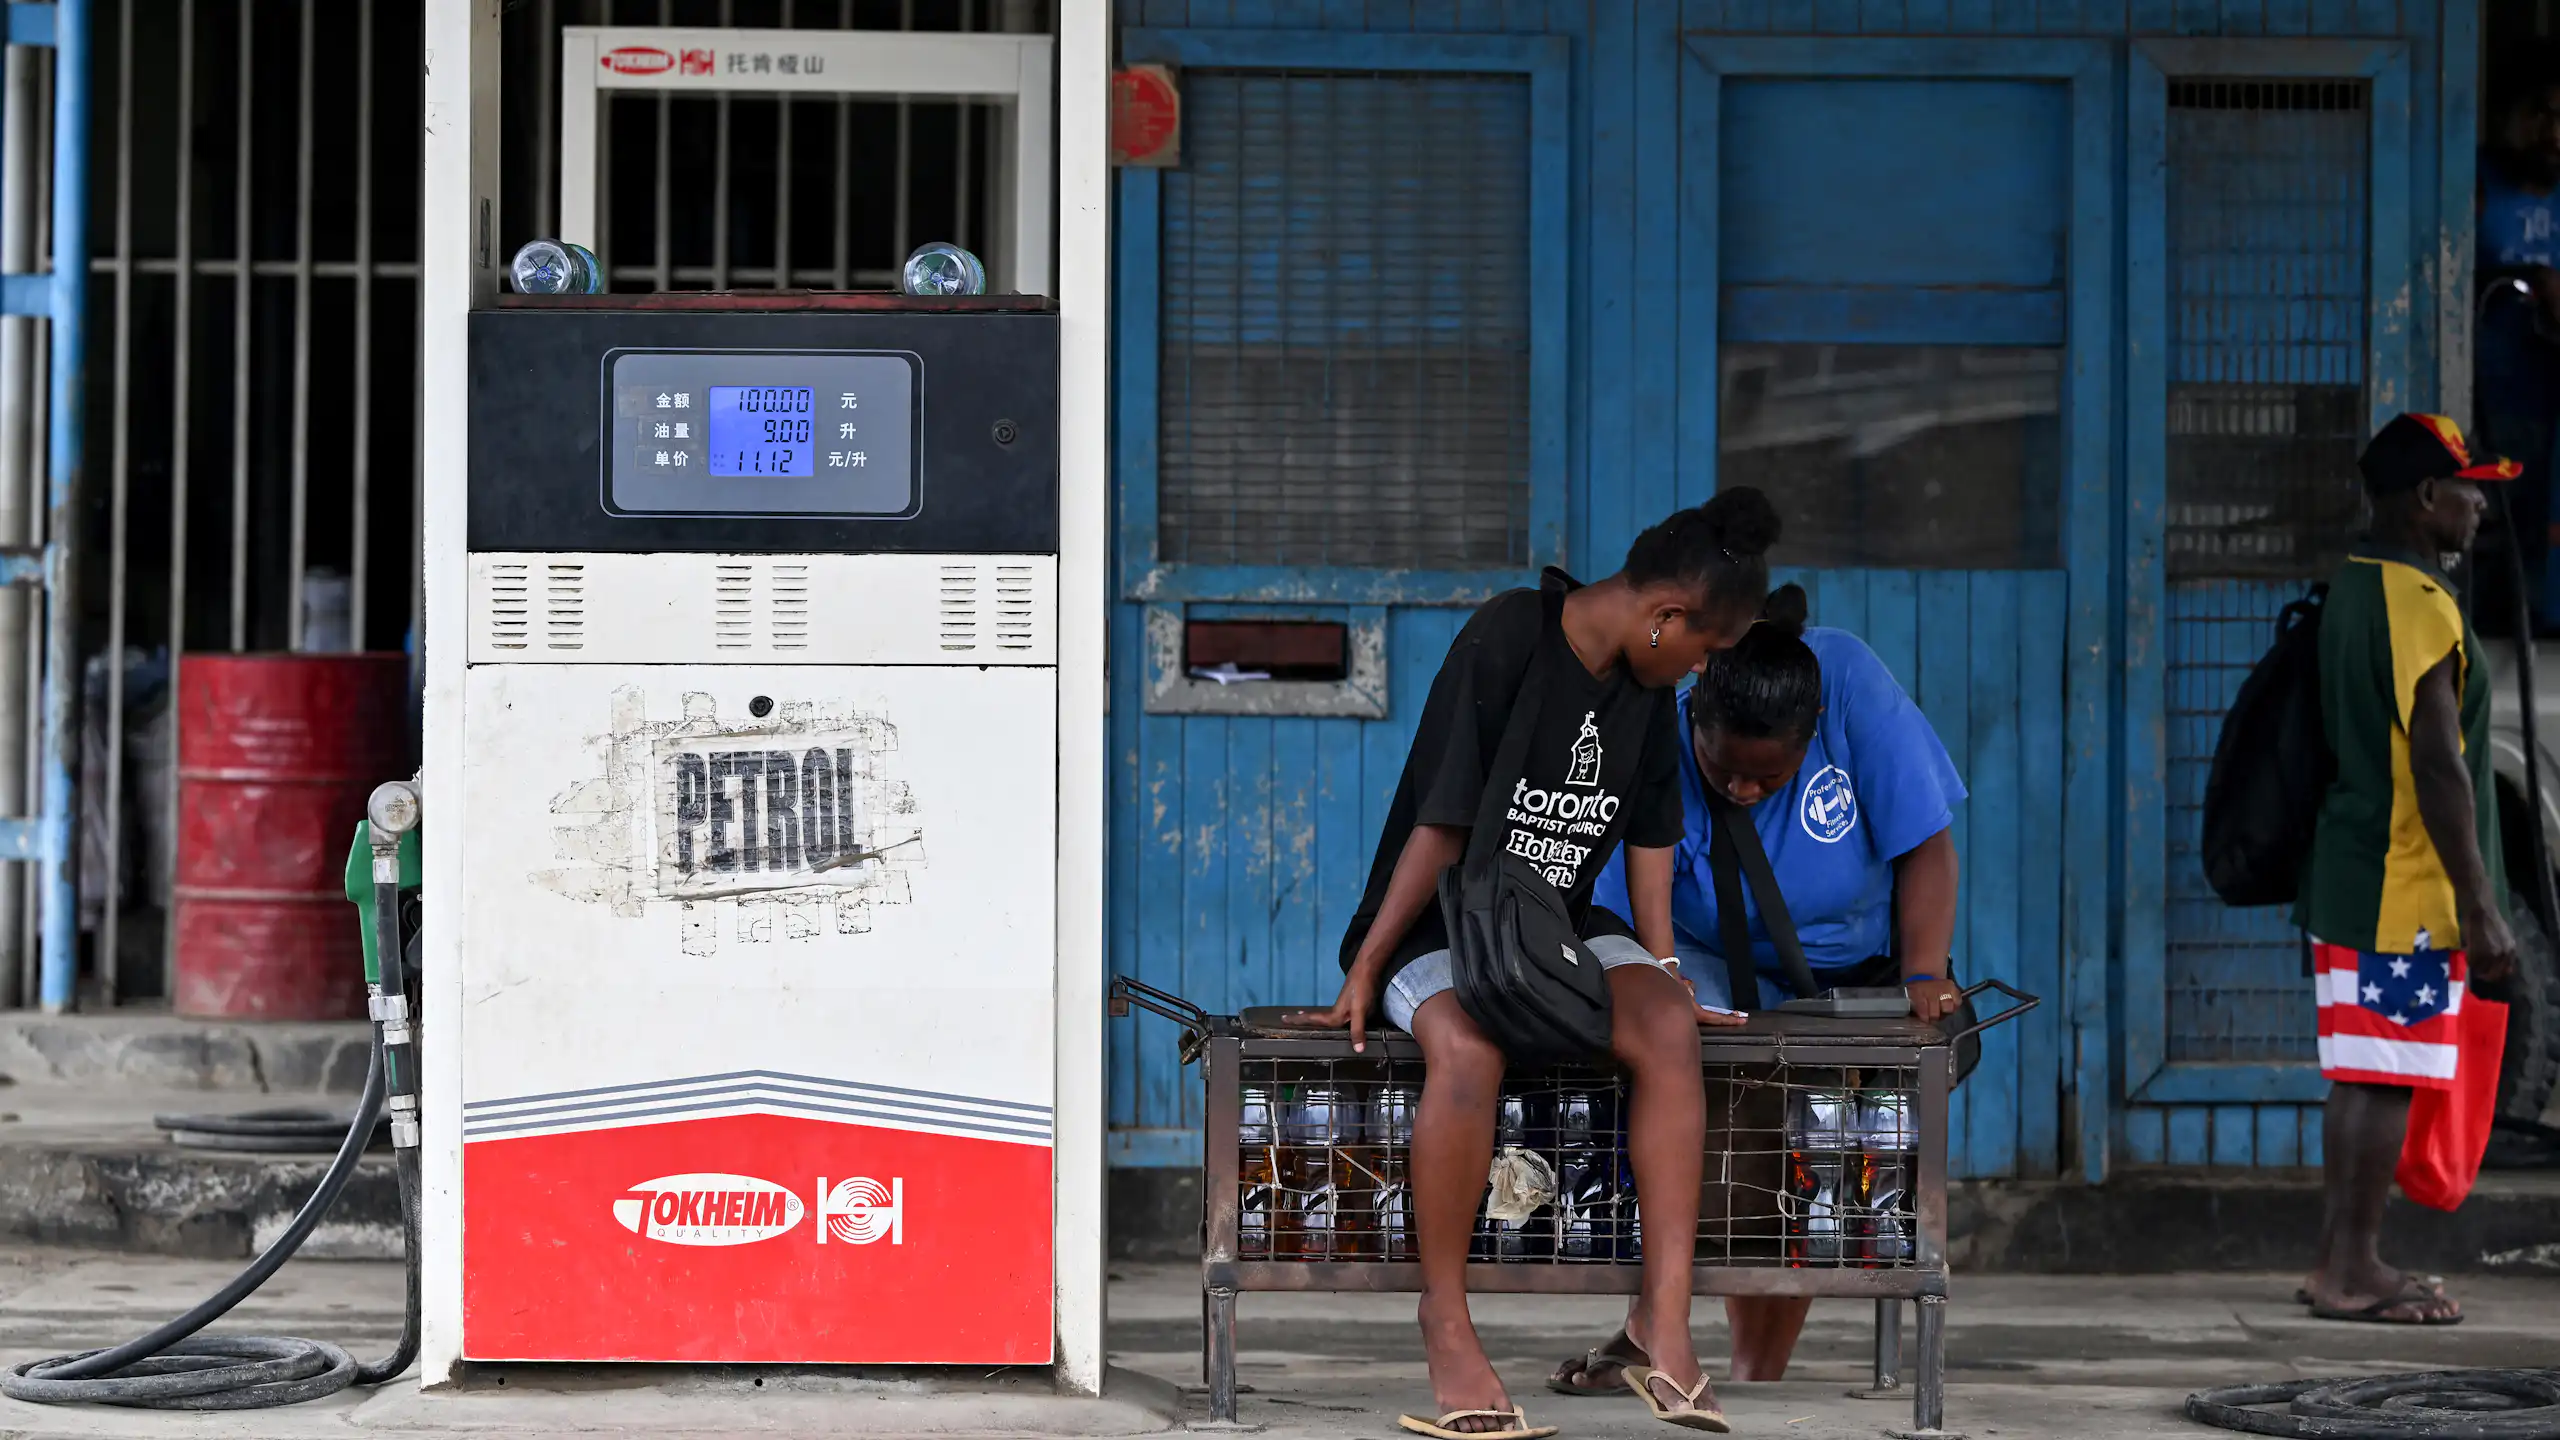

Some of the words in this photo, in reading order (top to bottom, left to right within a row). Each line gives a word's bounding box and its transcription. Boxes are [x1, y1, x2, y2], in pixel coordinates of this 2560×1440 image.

[656, 392, 690, 408] 金额
[738, 389, 810, 412] 100.00
[841, 393, 857, 409] 元
[654, 422, 690, 439] 油量
[764, 419, 810, 443] 9.00
[840, 422, 856, 439] 升
[655, 451, 689, 467] 单价
[738, 450, 793, 473] 11.12
[828, 451, 867, 468] 元/升
[676, 746, 863, 873] PETROL
[1513, 778, 1620, 822] toronto
[1506, 807, 1567, 834] BAPTIST
[1506, 829, 1591, 867] Holday
[656, 1228, 764, 1238] QUALITY
